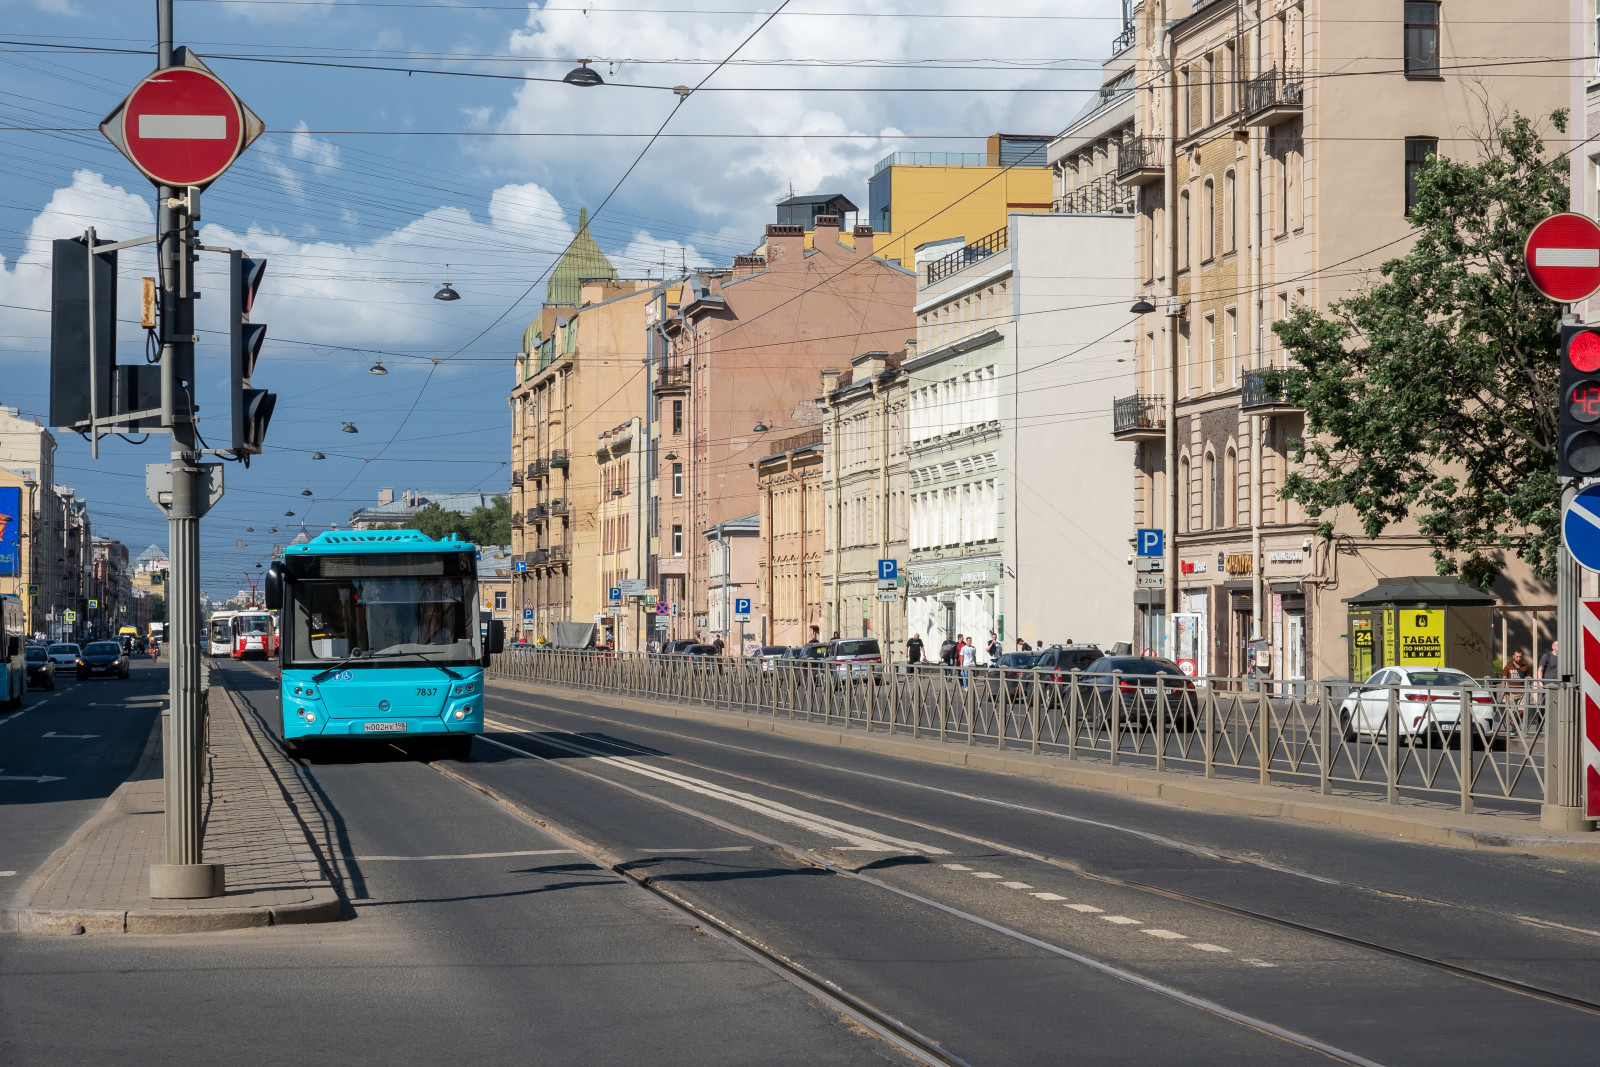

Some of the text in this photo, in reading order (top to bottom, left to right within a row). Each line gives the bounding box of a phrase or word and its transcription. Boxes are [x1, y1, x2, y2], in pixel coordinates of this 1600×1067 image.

[1573, 388, 1600, 414] 42
[1144, 532, 1158, 553] P
[883, 562, 893, 577] P
[739, 600, 748, 612] P
[1357, 633, 1371, 641] 24
[416, 688, 437, 696] 7837
